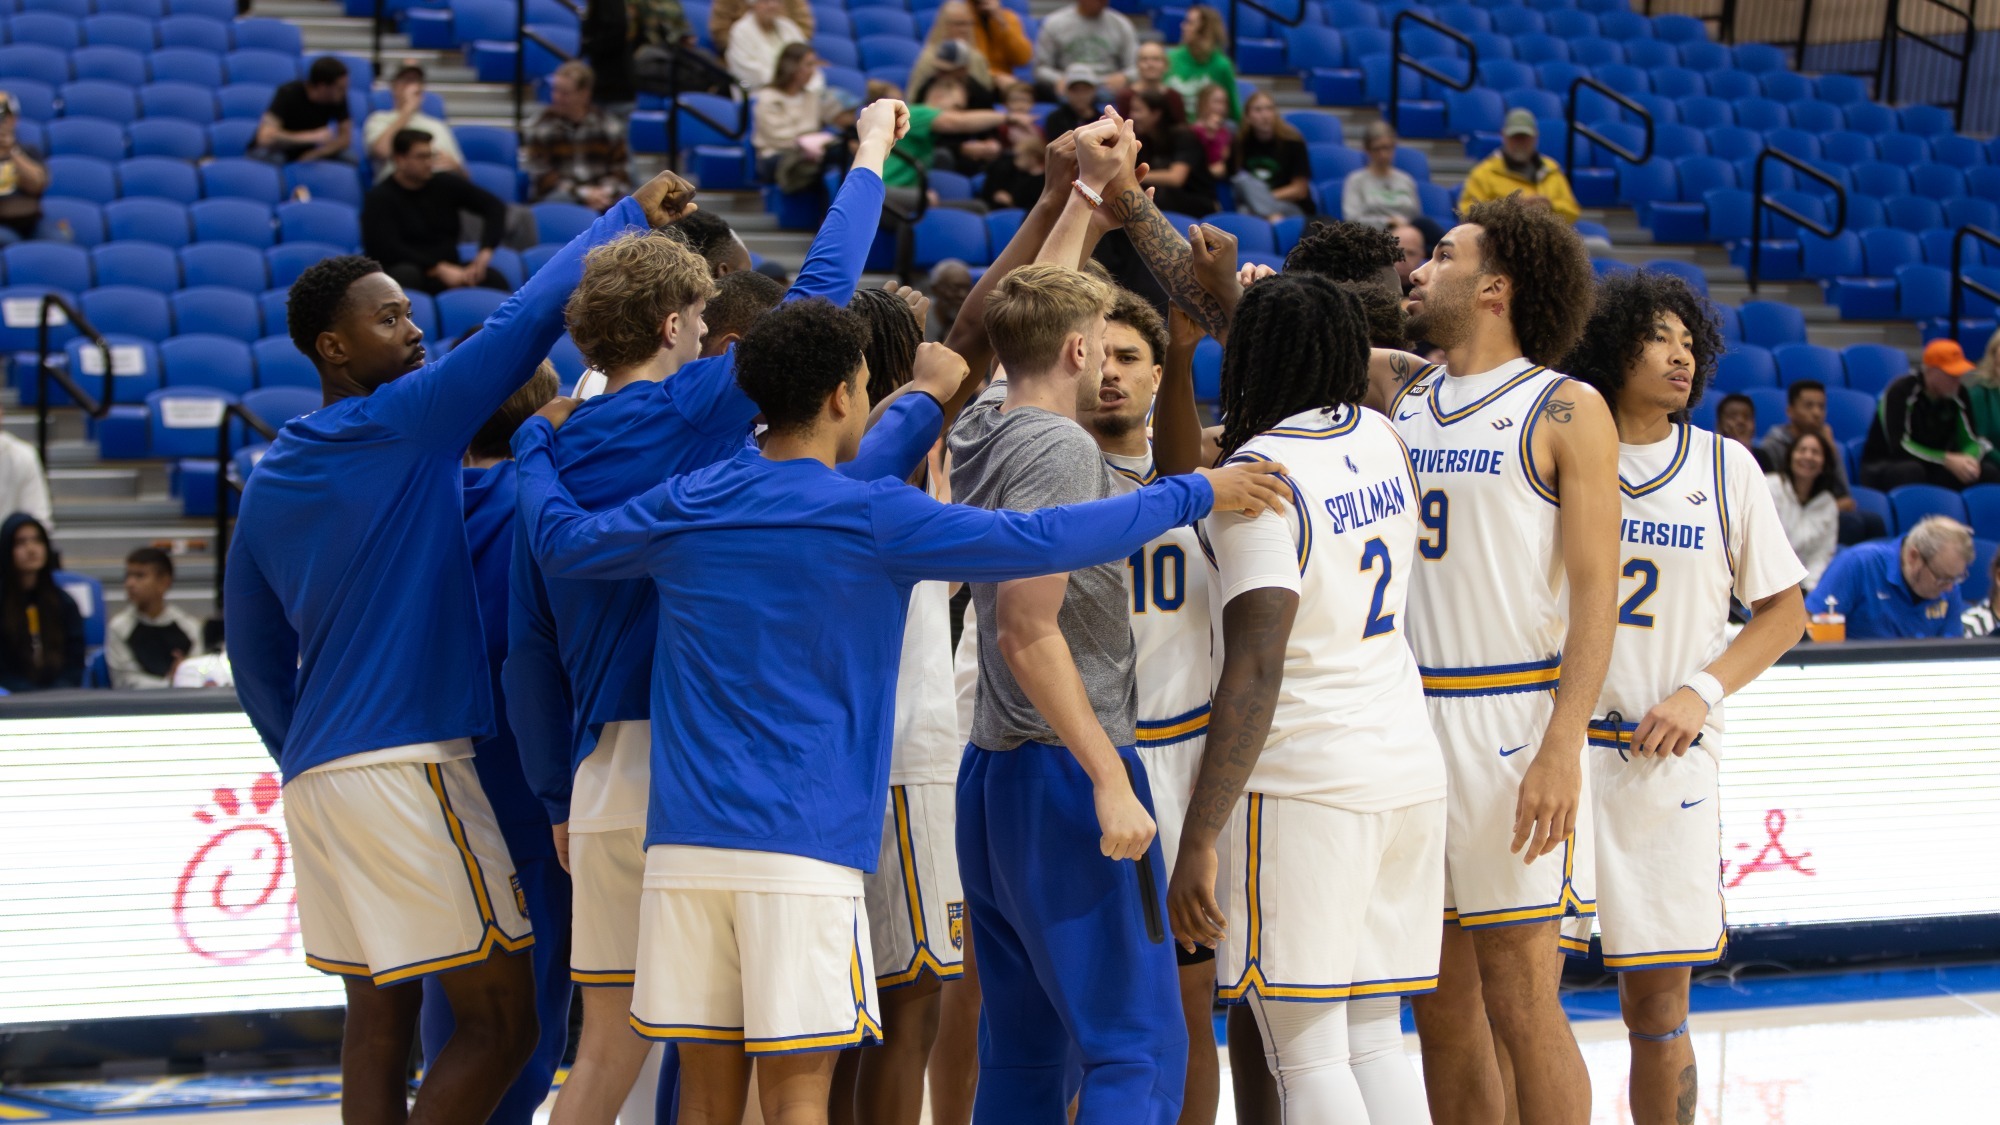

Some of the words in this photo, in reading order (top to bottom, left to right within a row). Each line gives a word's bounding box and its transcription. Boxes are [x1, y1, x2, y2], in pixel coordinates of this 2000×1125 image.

[1410, 448, 1504, 475] RIVERSIDE
[1324, 476, 1406, 535] SPILLMAN
[1417, 487, 1449, 562] 9
[1126, 543, 1187, 615] 10
[1359, 535, 1396, 642] 2
[1616, 556, 1661, 630] 2
